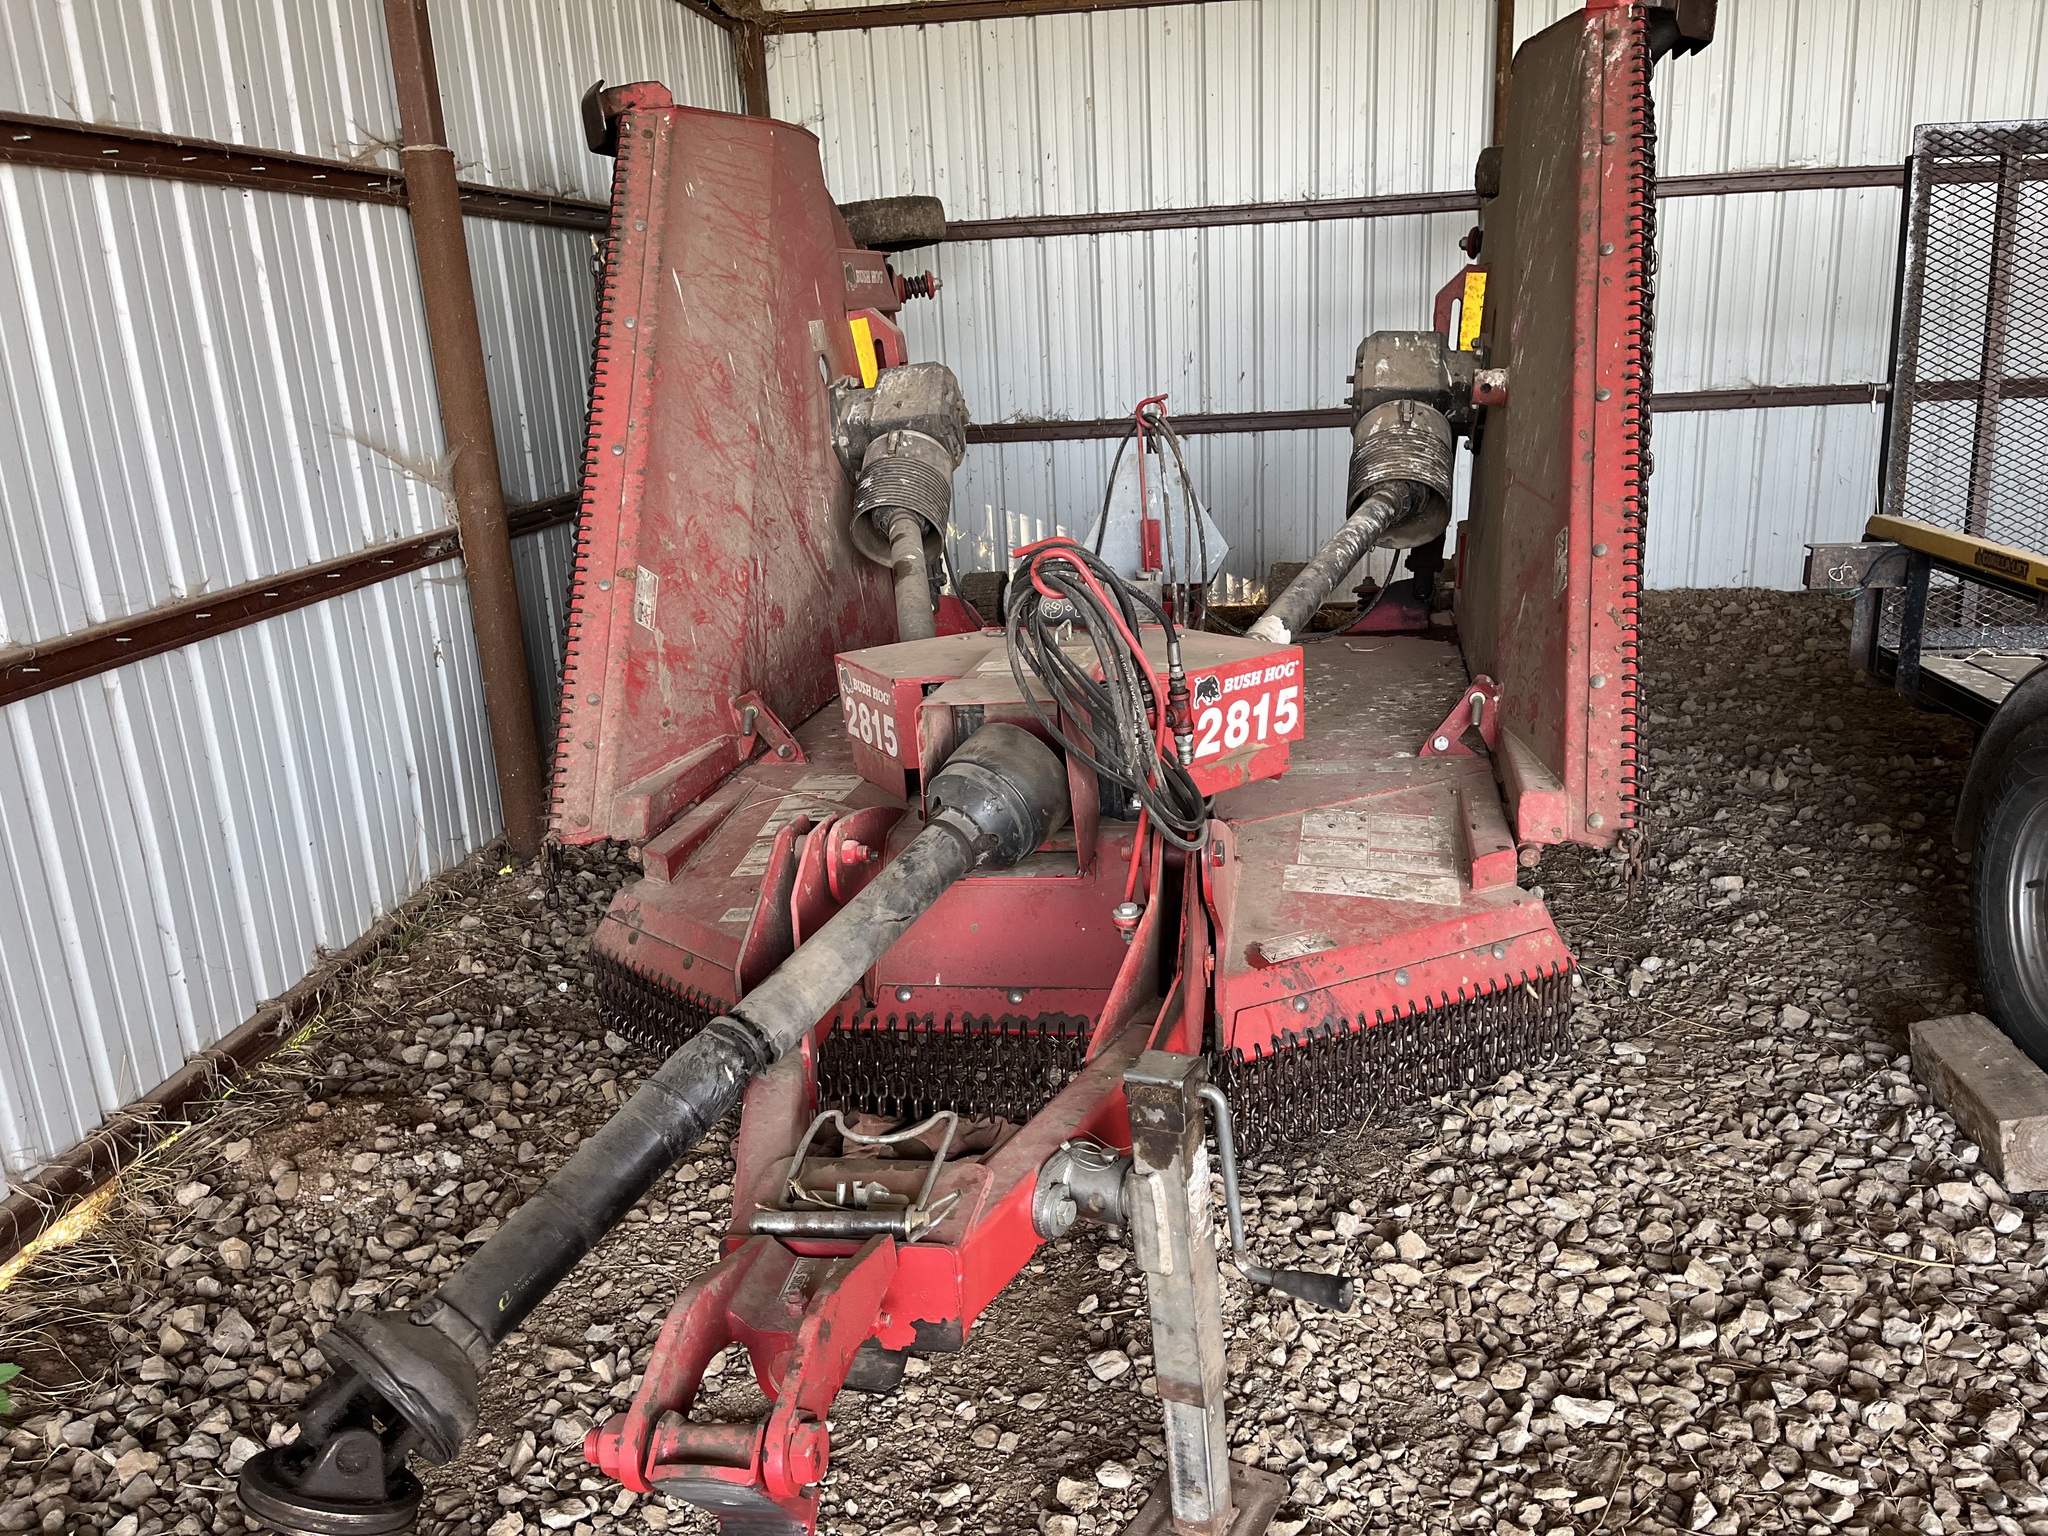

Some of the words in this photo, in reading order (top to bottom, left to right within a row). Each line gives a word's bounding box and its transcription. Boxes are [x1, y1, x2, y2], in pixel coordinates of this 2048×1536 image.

[855, 269, 871, 284] BUSH
[871, 270, 884, 284] HOG
[852, 677, 872, 698] BUSH
[872, 686, 890, 706] HOG
[1222, 669, 1263, 694] BUSH
[1263, 661, 1298, 683] HOG
[845, 696, 898, 757] 2815
[1194, 685, 1299, 759] 2815
